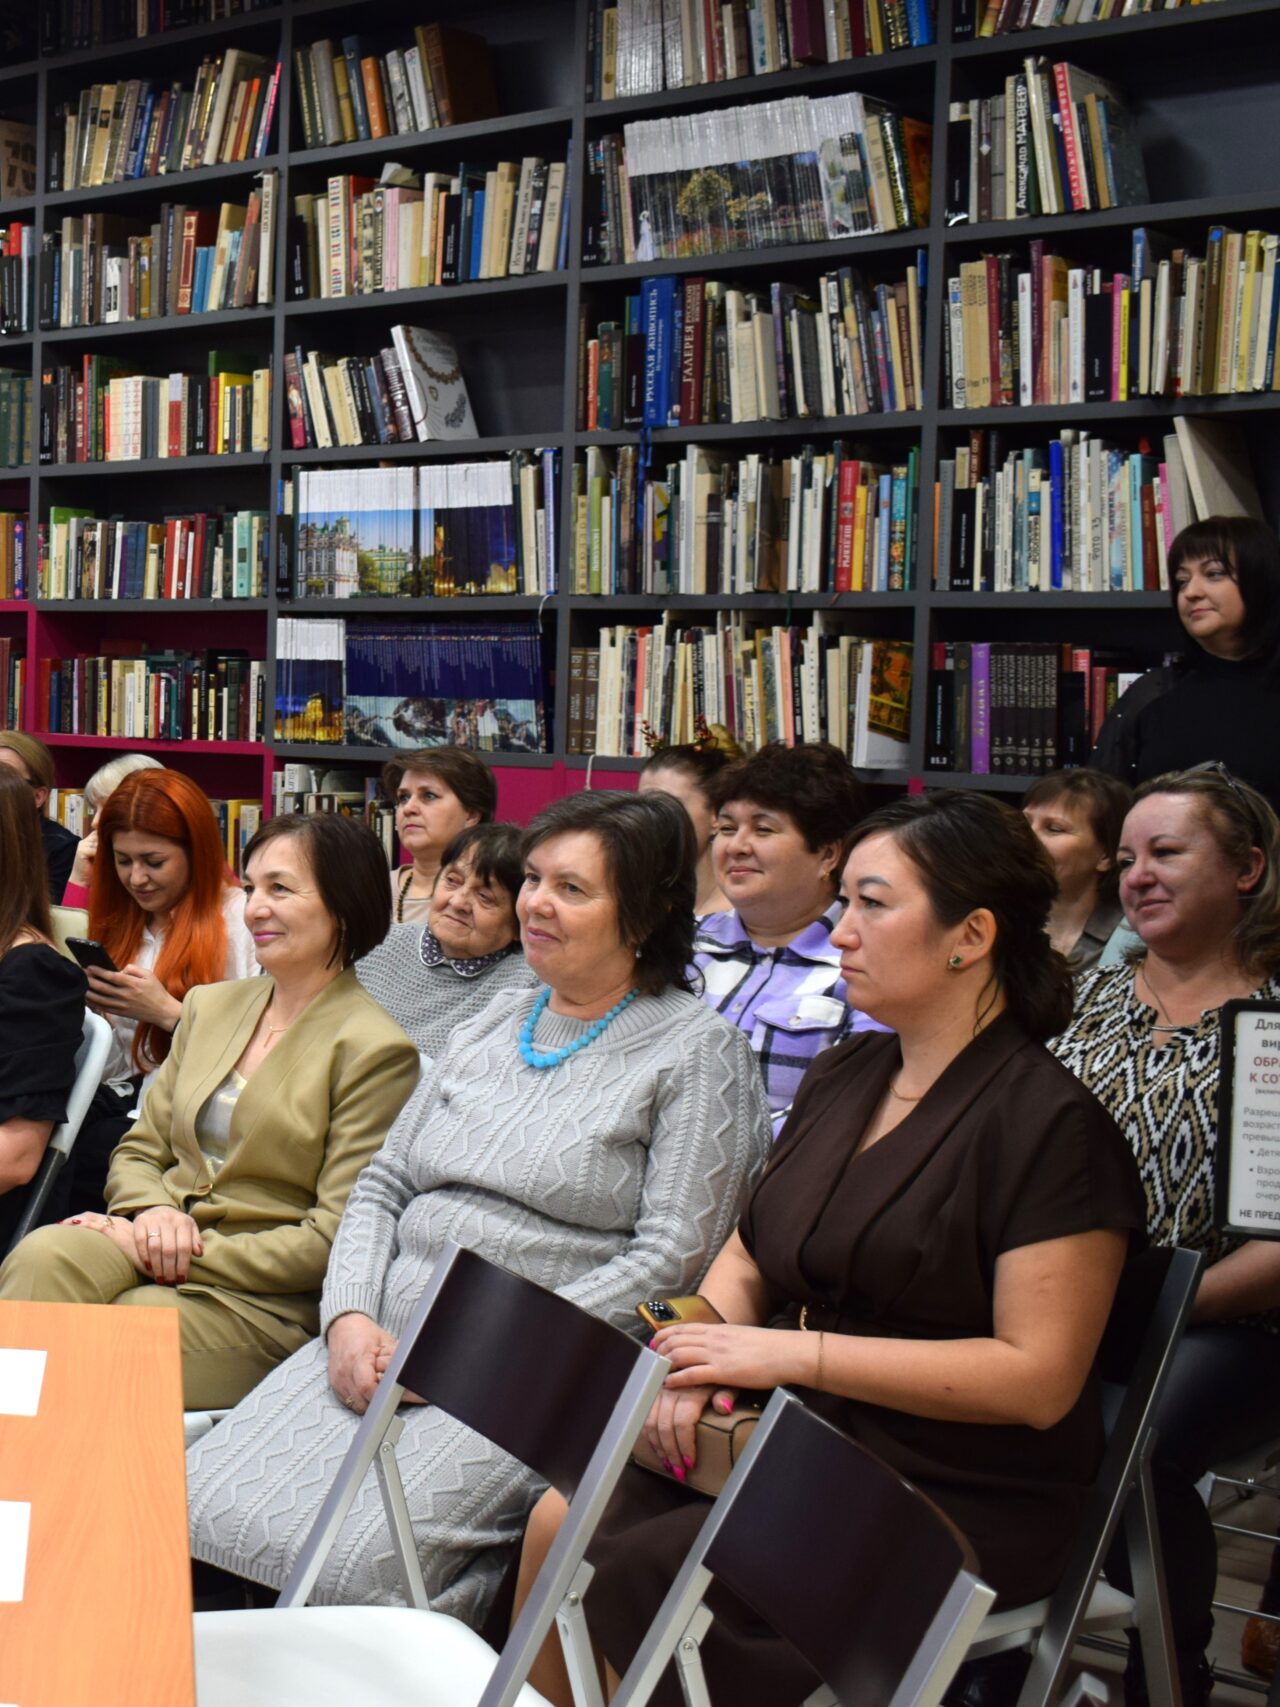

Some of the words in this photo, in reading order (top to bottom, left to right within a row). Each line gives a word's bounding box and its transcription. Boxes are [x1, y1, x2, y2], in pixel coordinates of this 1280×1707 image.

[647, 289, 658, 350] ЖИВОПИСЬ
[682, 325, 694, 383] ГАЛЕРЕЯ
[646, 355, 656, 402] РУССКАЯ
[1255, 1018, 1280, 1031] Для
[1254, 1056, 1280, 1067] ОБР
[1249, 1072, 1258, 1082] К
[1262, 1073, 1280, 1084] СО
[1239, 1209, 1252, 1217] НЕ
